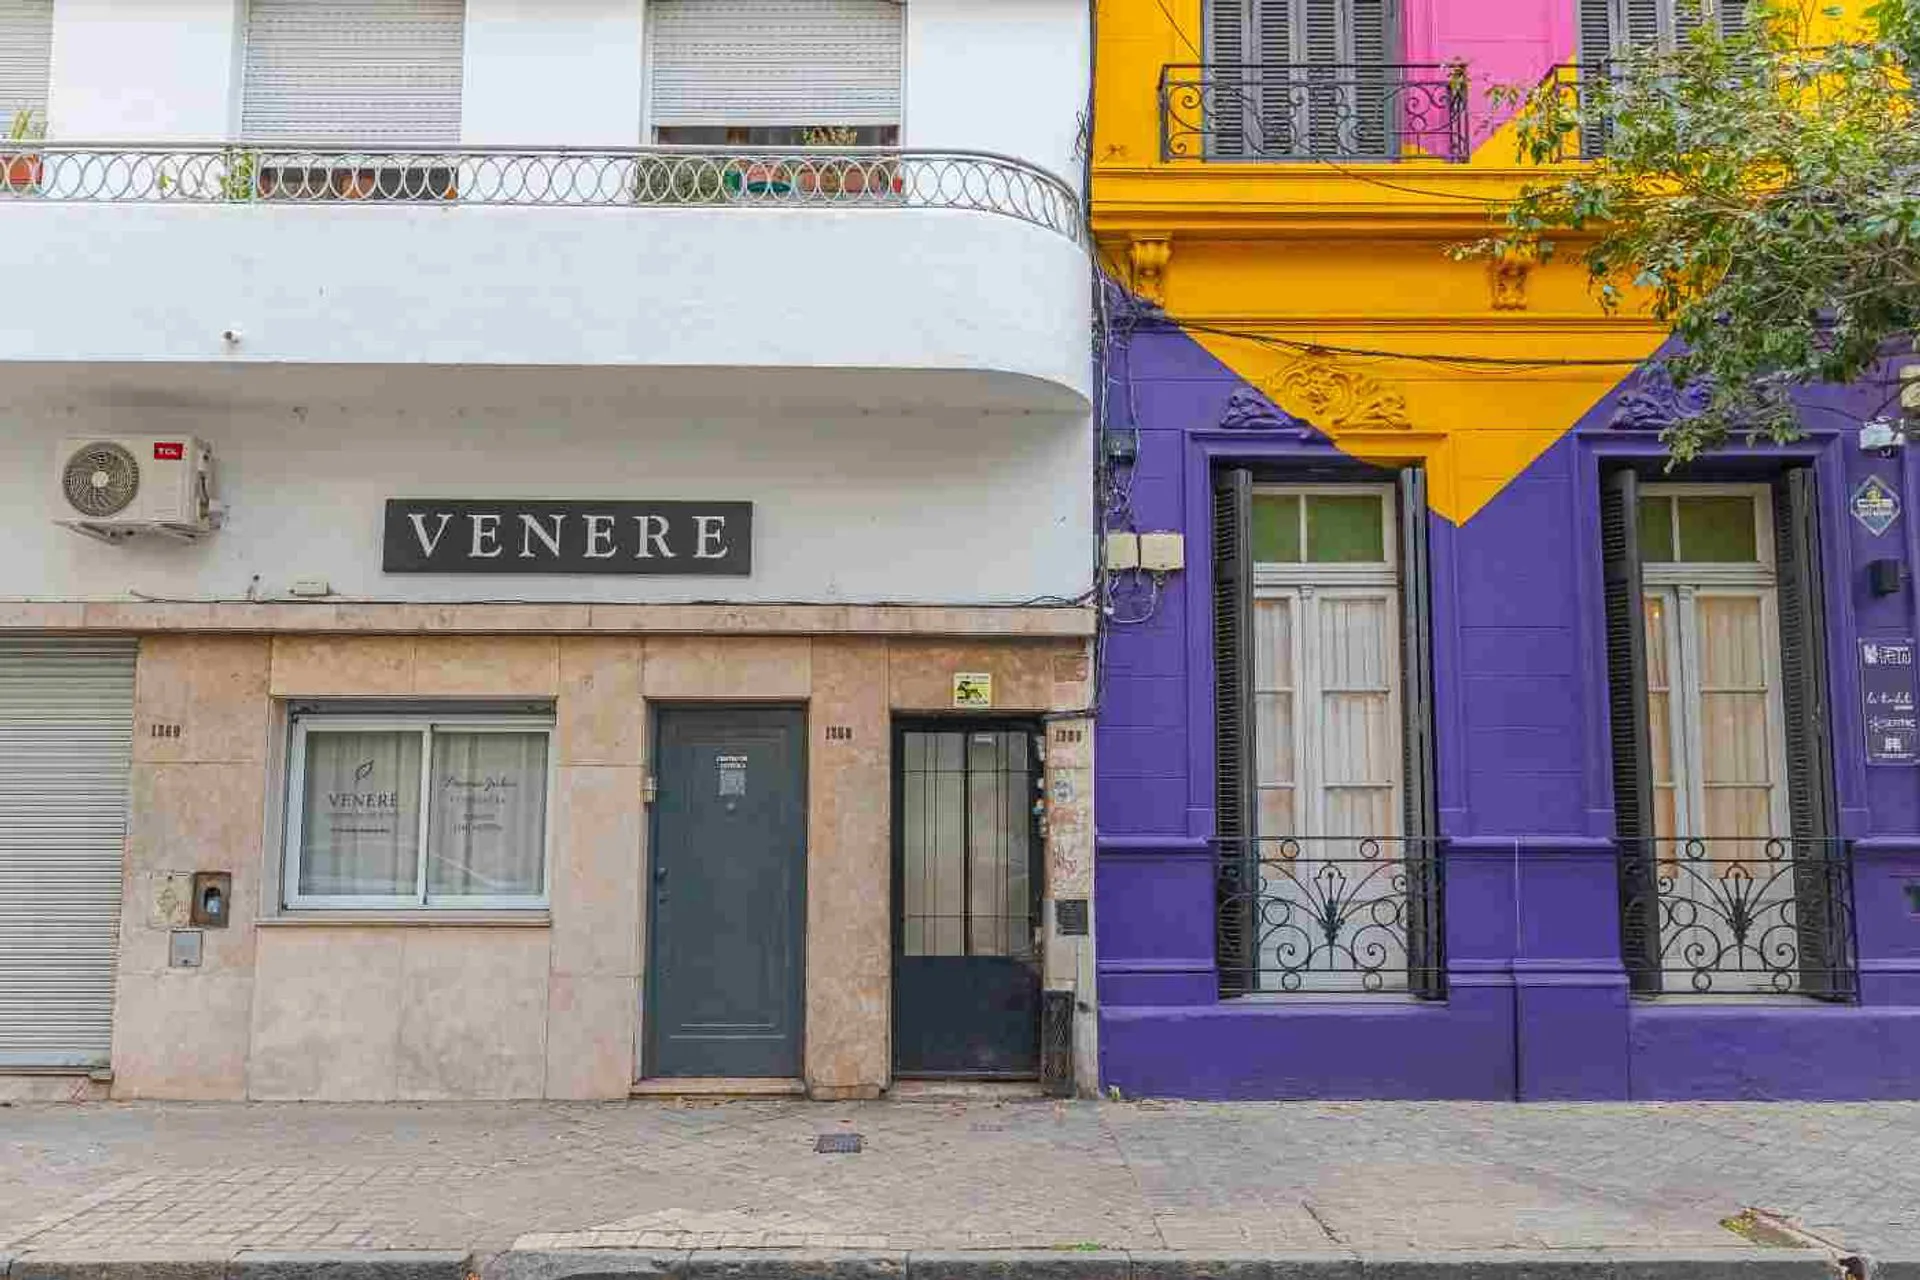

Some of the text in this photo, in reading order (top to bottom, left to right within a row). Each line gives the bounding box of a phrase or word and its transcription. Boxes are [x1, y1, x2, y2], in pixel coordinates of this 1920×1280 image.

[157, 447, 178, 456] TCL
[407, 513, 729, 559] VENERE
[328, 793, 397, 808] VENERE
